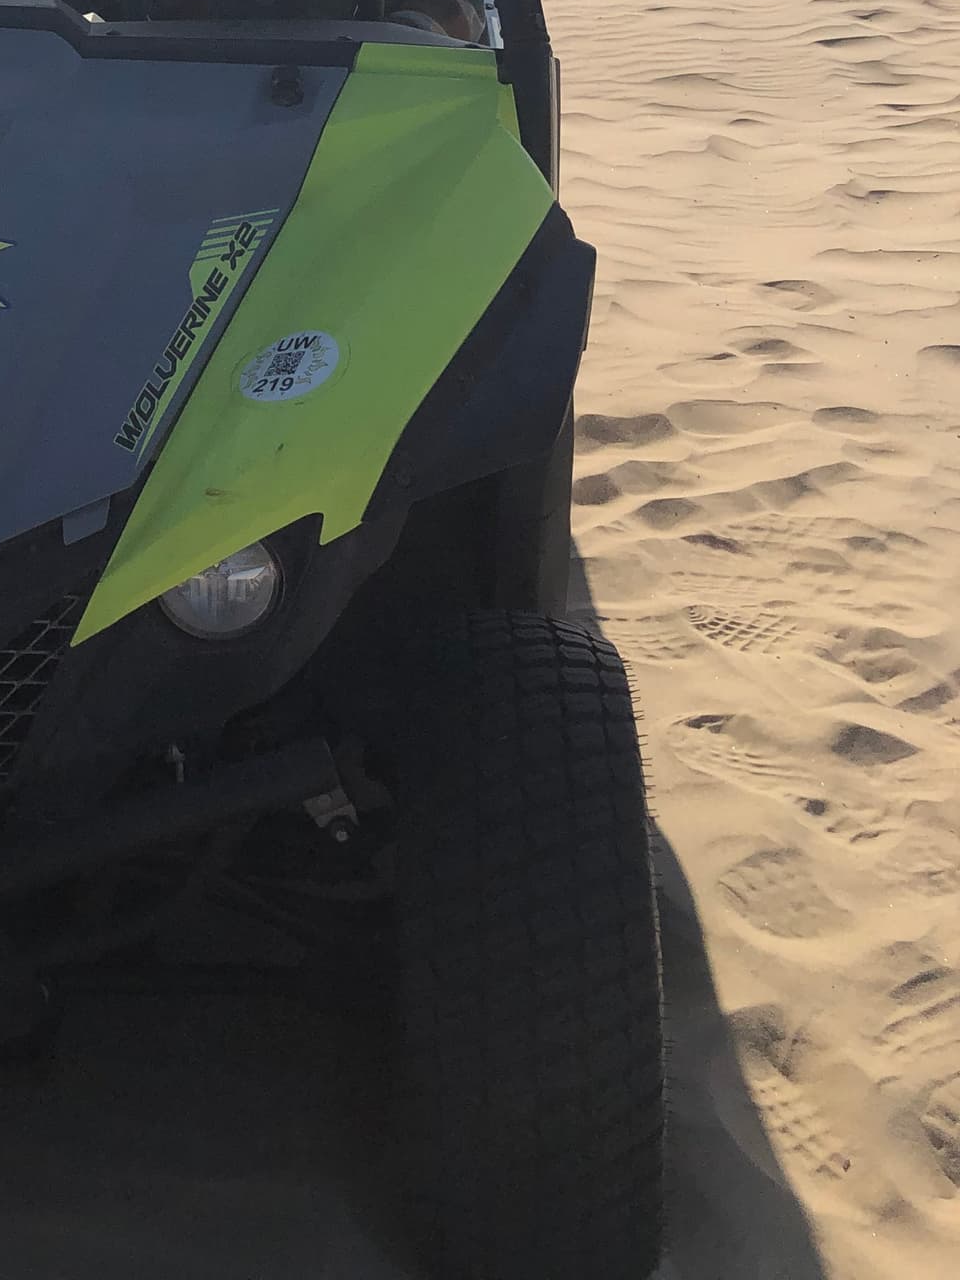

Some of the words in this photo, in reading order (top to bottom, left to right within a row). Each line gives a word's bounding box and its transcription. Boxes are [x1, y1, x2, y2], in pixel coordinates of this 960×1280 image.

[114, 267, 229, 452] WOLVERINE
[221, 221, 257, 270] X2
[276, 335, 318, 352] UW
[252, 376, 295, 394] 219
